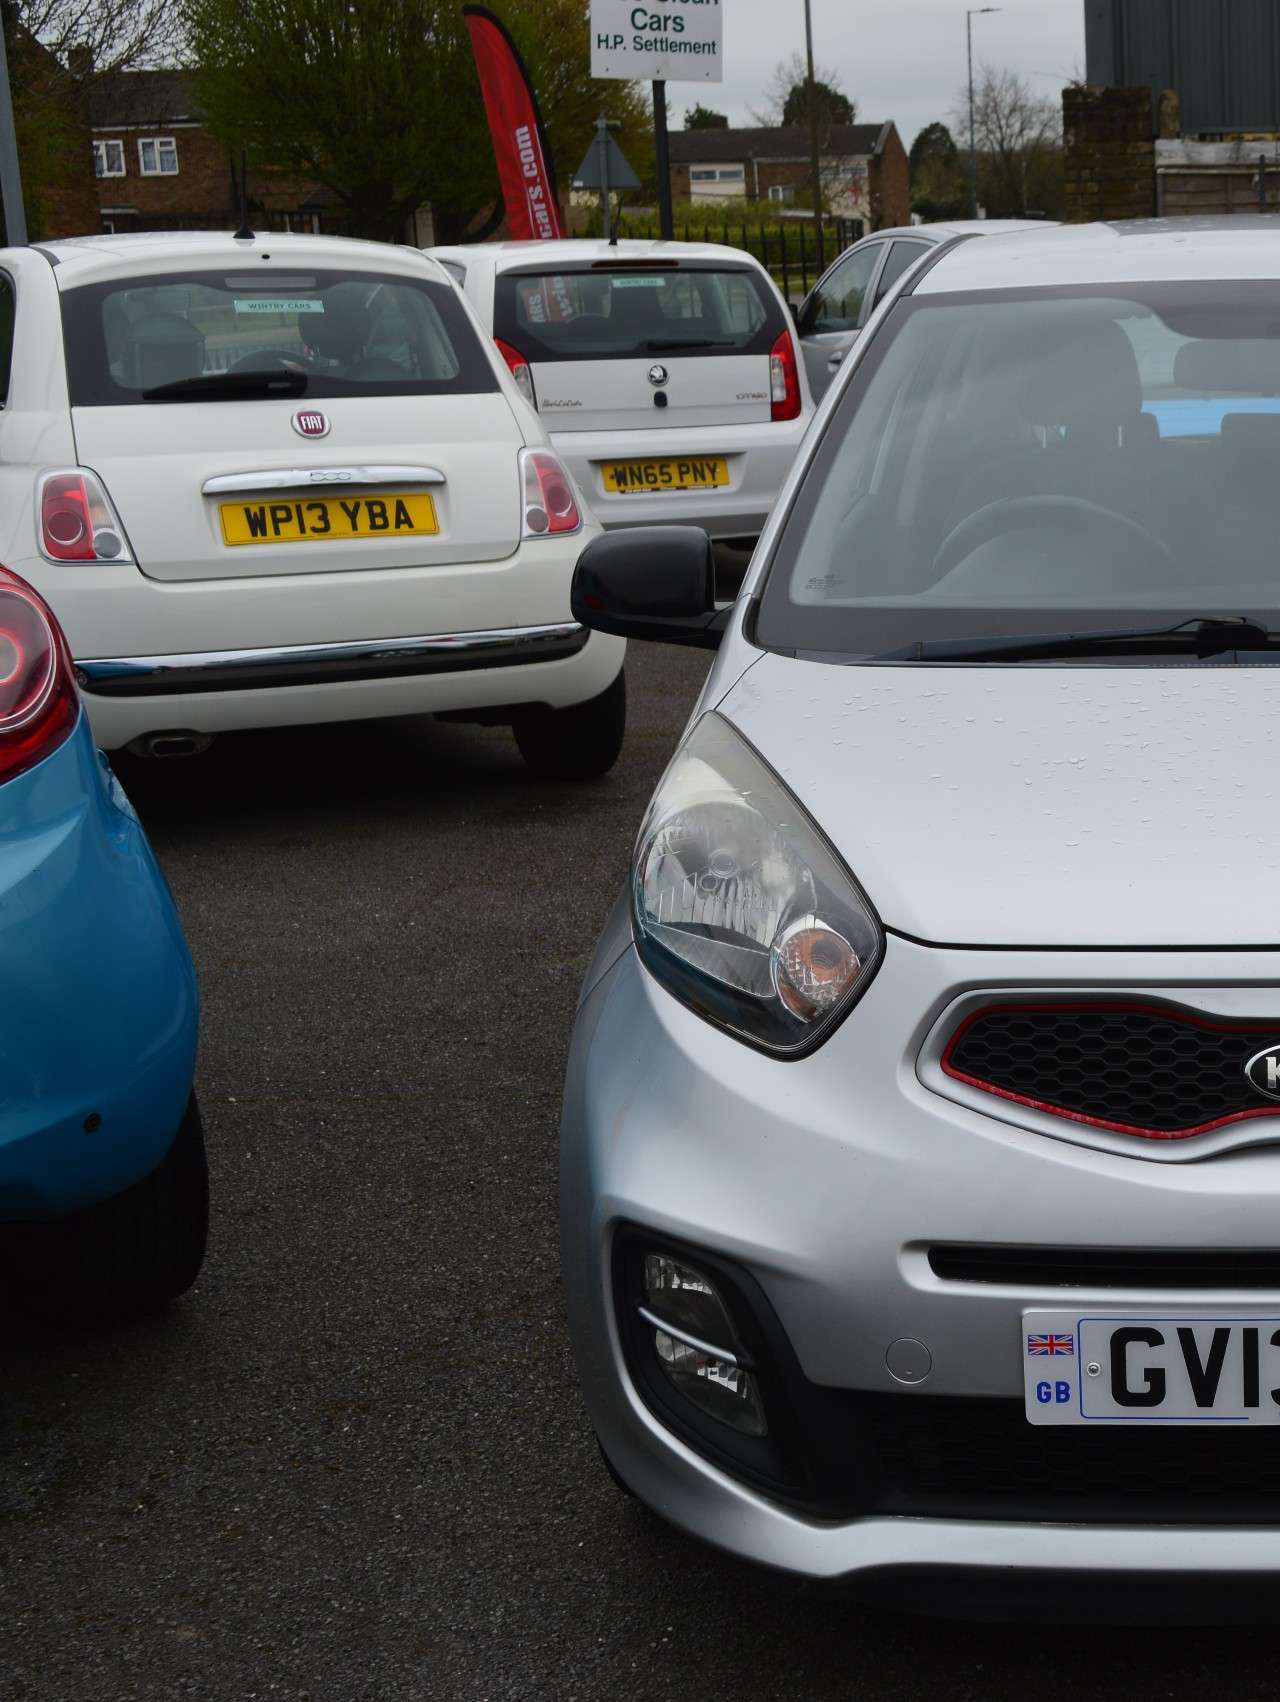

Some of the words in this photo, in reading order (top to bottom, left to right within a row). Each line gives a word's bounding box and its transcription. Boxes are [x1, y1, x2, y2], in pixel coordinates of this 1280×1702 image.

[630, 7, 685, 32] Cars
[597, 33, 627, 51] H.P.
[633, 35, 717, 55] Settlement
[287, 302, 312, 310] CARS
[300, 415, 323, 430] FIAT
[613, 463, 673, 487] WN65
[676, 461, 718, 483] PNY
[244, 502, 331, 538] WP13
[340, 498, 415, 532] YBA
[1036, 1380, 1071, 1404] GB
